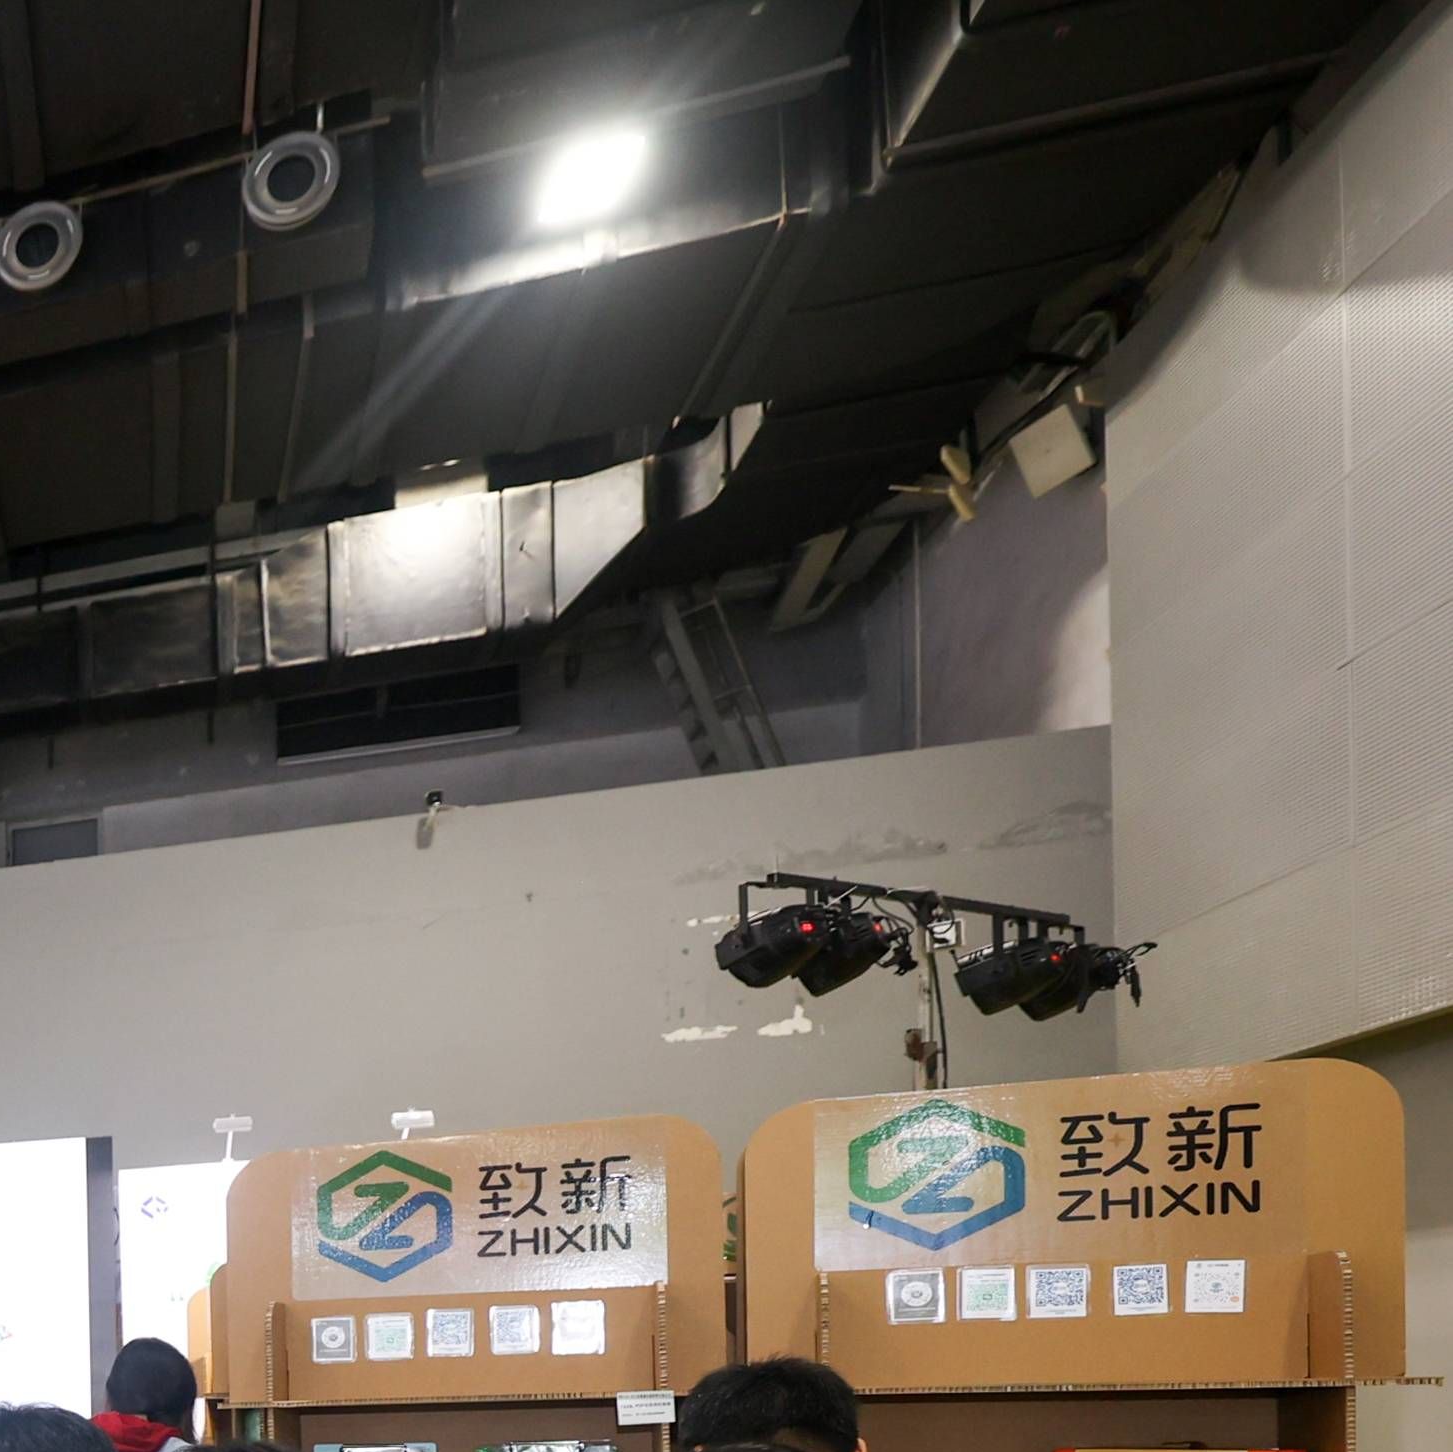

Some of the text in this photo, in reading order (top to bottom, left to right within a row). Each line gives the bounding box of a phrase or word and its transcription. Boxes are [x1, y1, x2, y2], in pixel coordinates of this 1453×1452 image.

[1058, 1102, 1263, 1178] 致新
[476, 1155, 632, 1219] 致新
[1056, 1179, 1262, 1222] ZHIXIN
[476, 1222, 633, 1258] ZHIXIN
